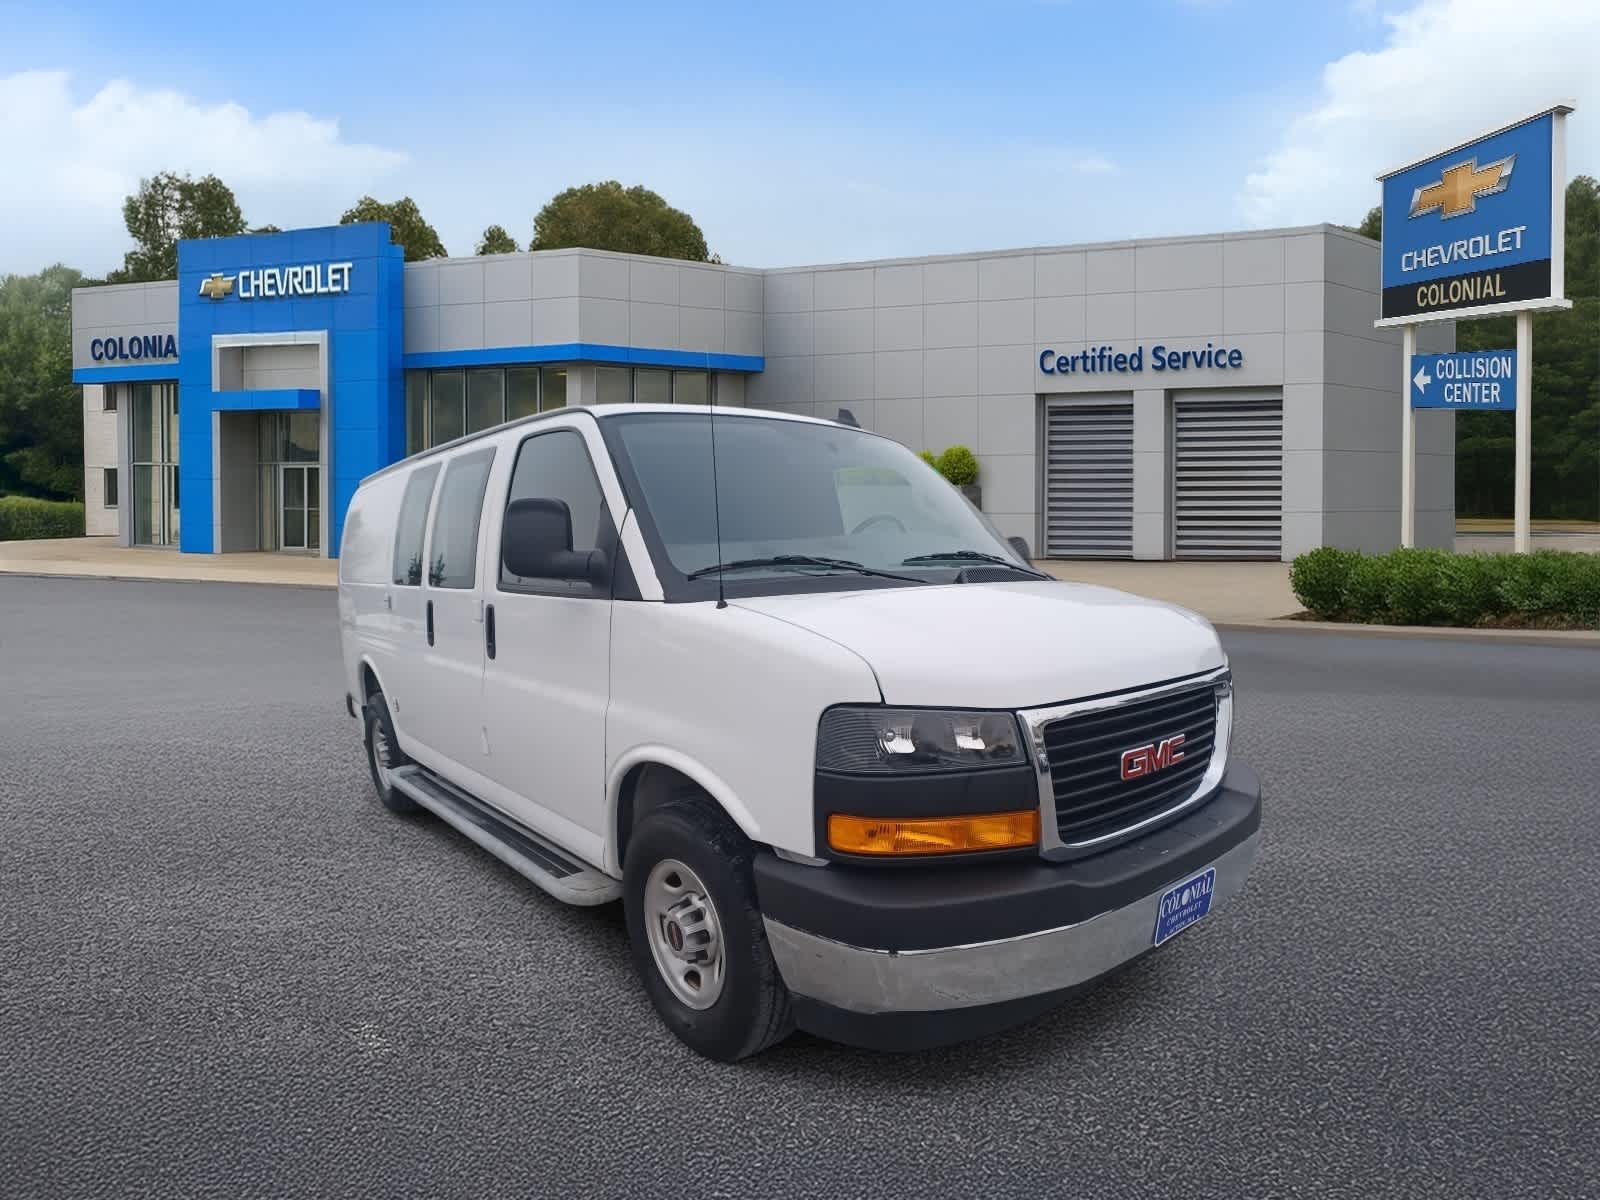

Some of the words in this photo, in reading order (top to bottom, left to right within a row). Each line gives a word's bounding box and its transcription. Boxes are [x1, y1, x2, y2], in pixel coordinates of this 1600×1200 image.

[1401, 225, 1527, 273] CHEVROLET
[238, 262, 353, 298] CHEVROLET
[1416, 274, 1506, 307] COLONIAL
[1039, 345, 1144, 374] Certified
[1151, 343, 1243, 371] Service
[1436, 356, 1512, 380] COLLISION
[1444, 381, 1501, 404] CENTER
[1121, 733, 1186, 781] GMC
